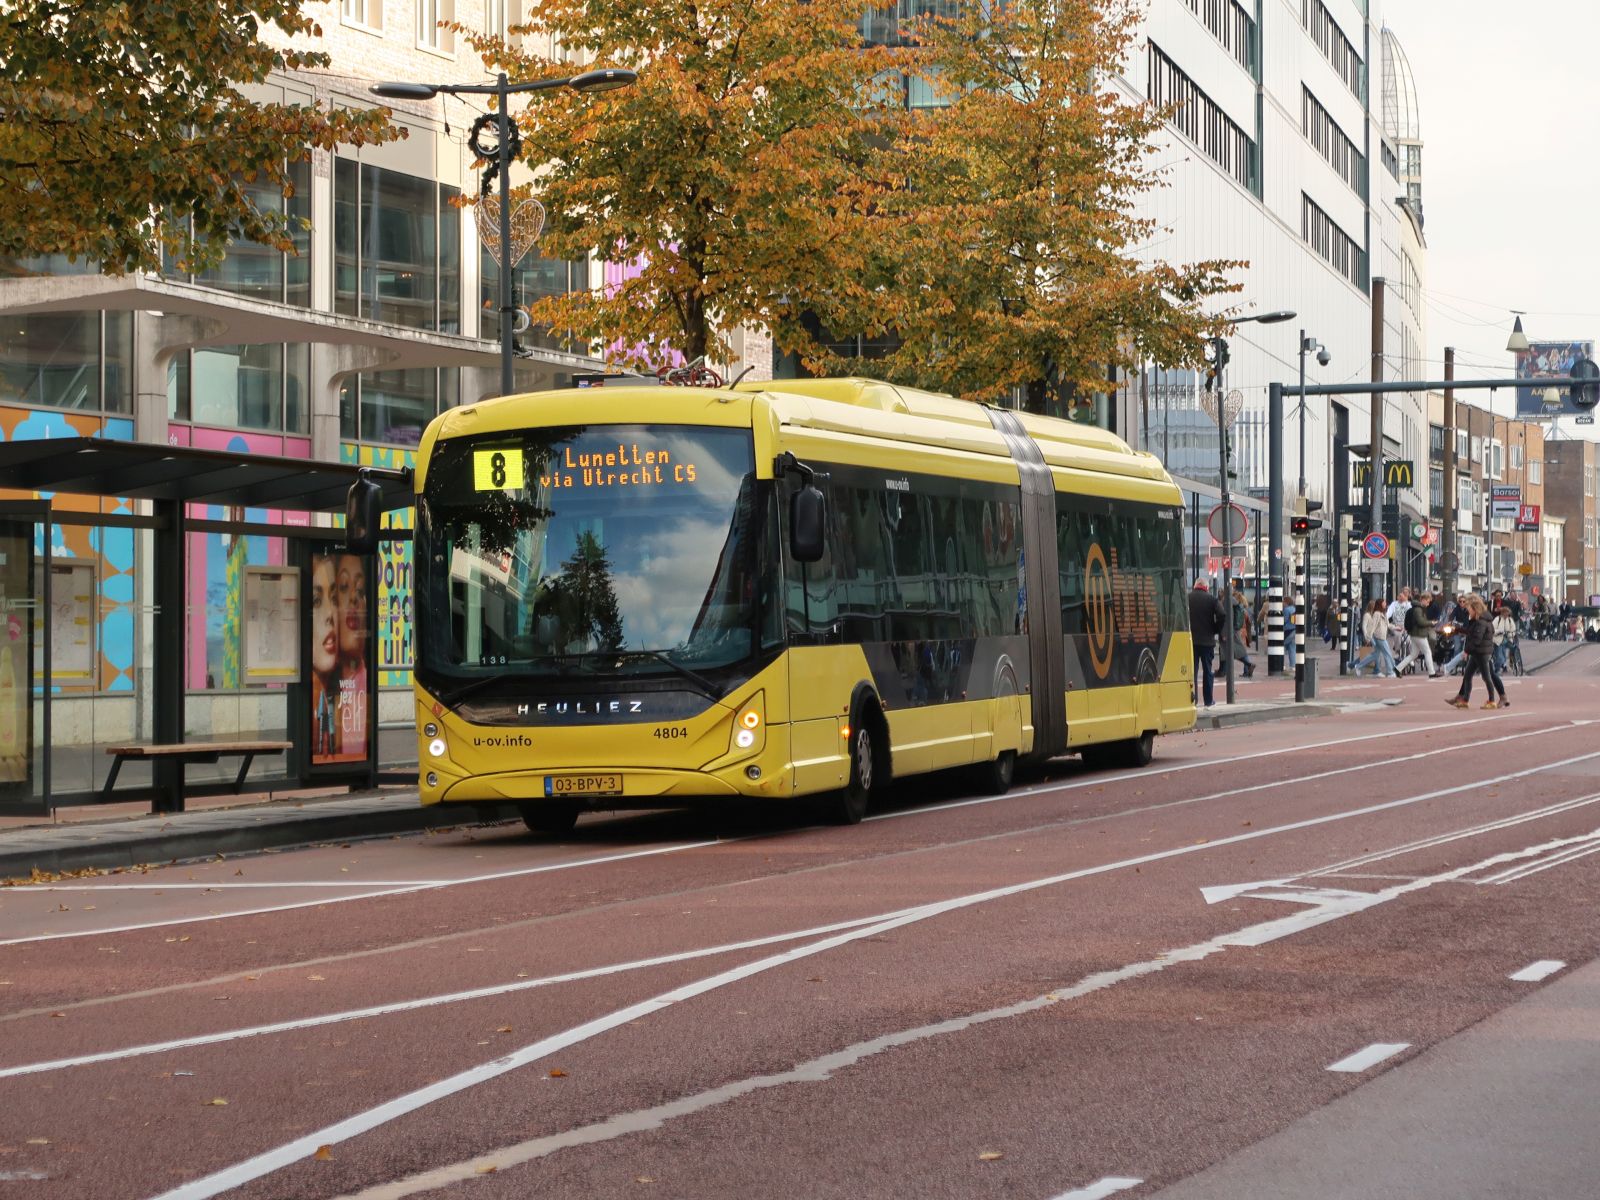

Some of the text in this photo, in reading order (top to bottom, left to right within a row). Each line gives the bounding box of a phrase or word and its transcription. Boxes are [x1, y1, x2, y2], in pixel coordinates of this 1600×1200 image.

[565, 444, 670, 468] Lunetten
[490, 452, 506, 489] 8
[540, 464, 697, 488] via Utrecht CS
[517, 701, 643, 715] HEULIEZ
[653, 727, 688, 739] 4804
[474, 735, 532, 747] u-ov.info
[555, 777, 616, 791] 03-BPV-3
